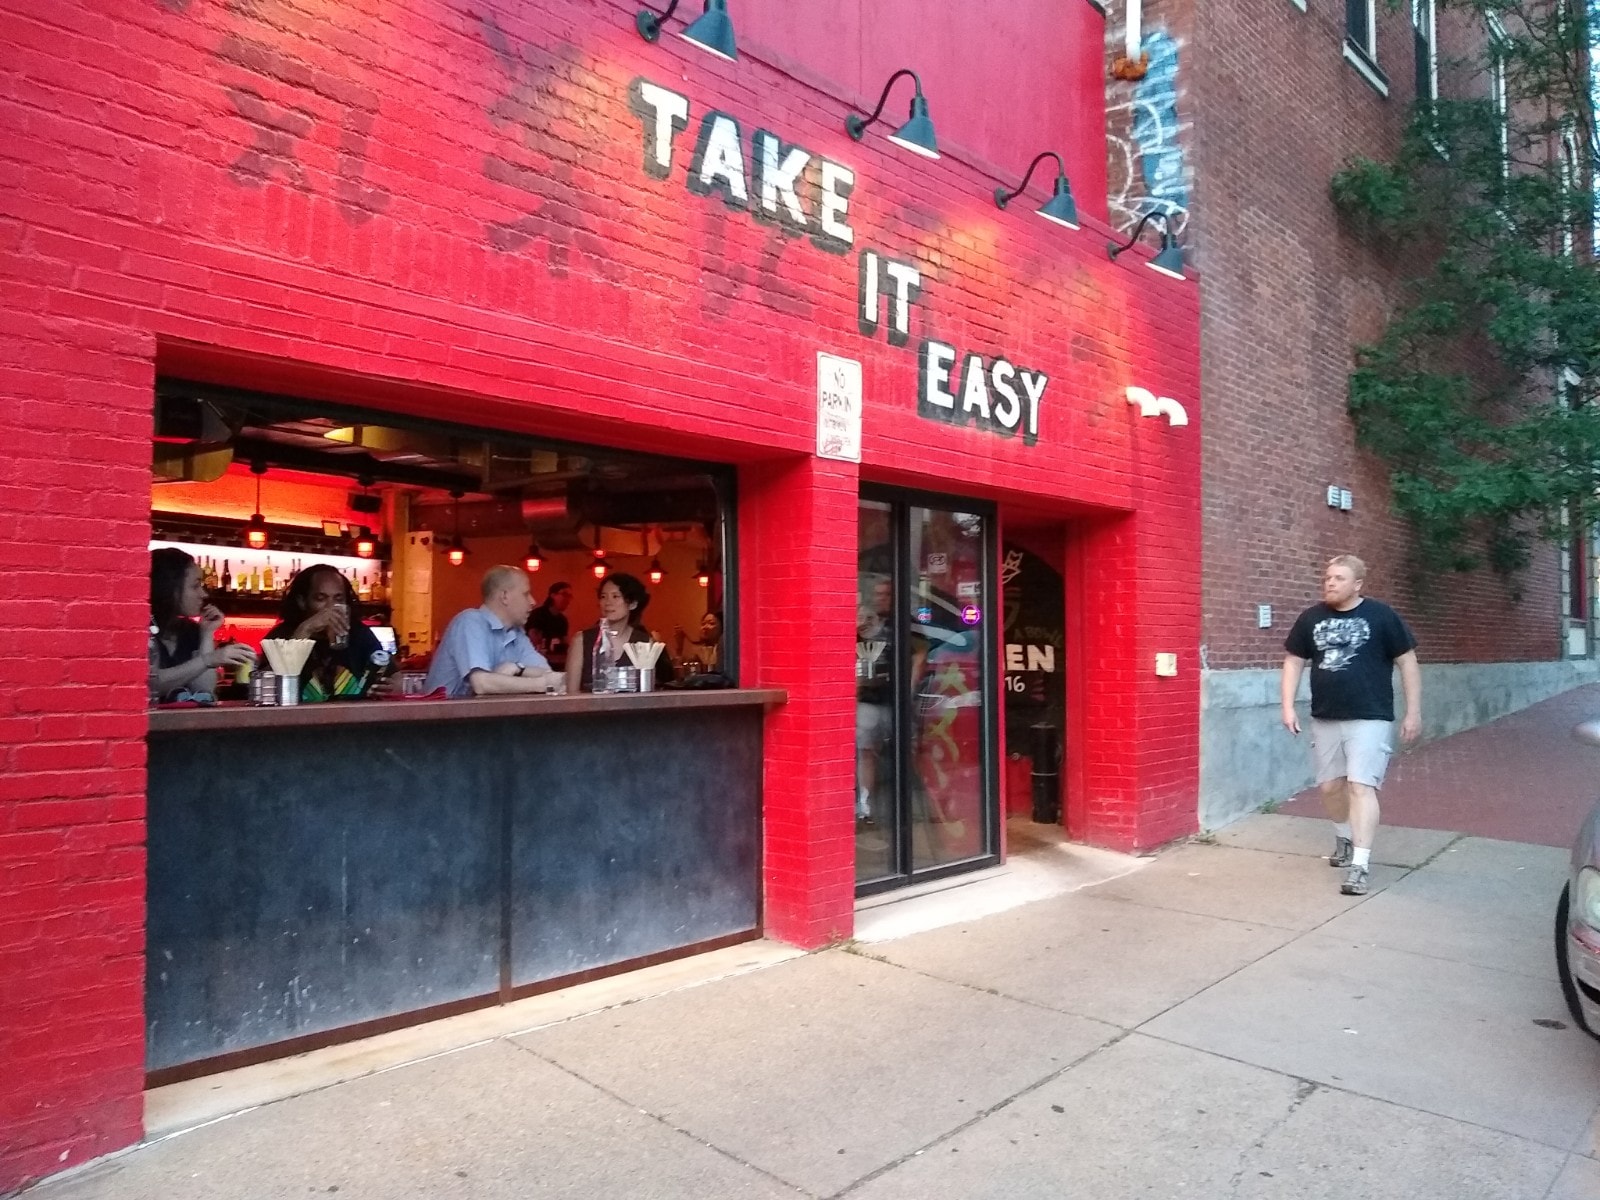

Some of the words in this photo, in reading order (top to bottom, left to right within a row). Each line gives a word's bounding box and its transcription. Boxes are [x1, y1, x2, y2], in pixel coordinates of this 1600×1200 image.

[639, 80, 855, 246] TAKE
[864, 251, 920, 336] IT
[834, 368, 846, 389] NO
[925, 340, 1048, 436] EASY
[1004, 675, 1026, 693] 16
